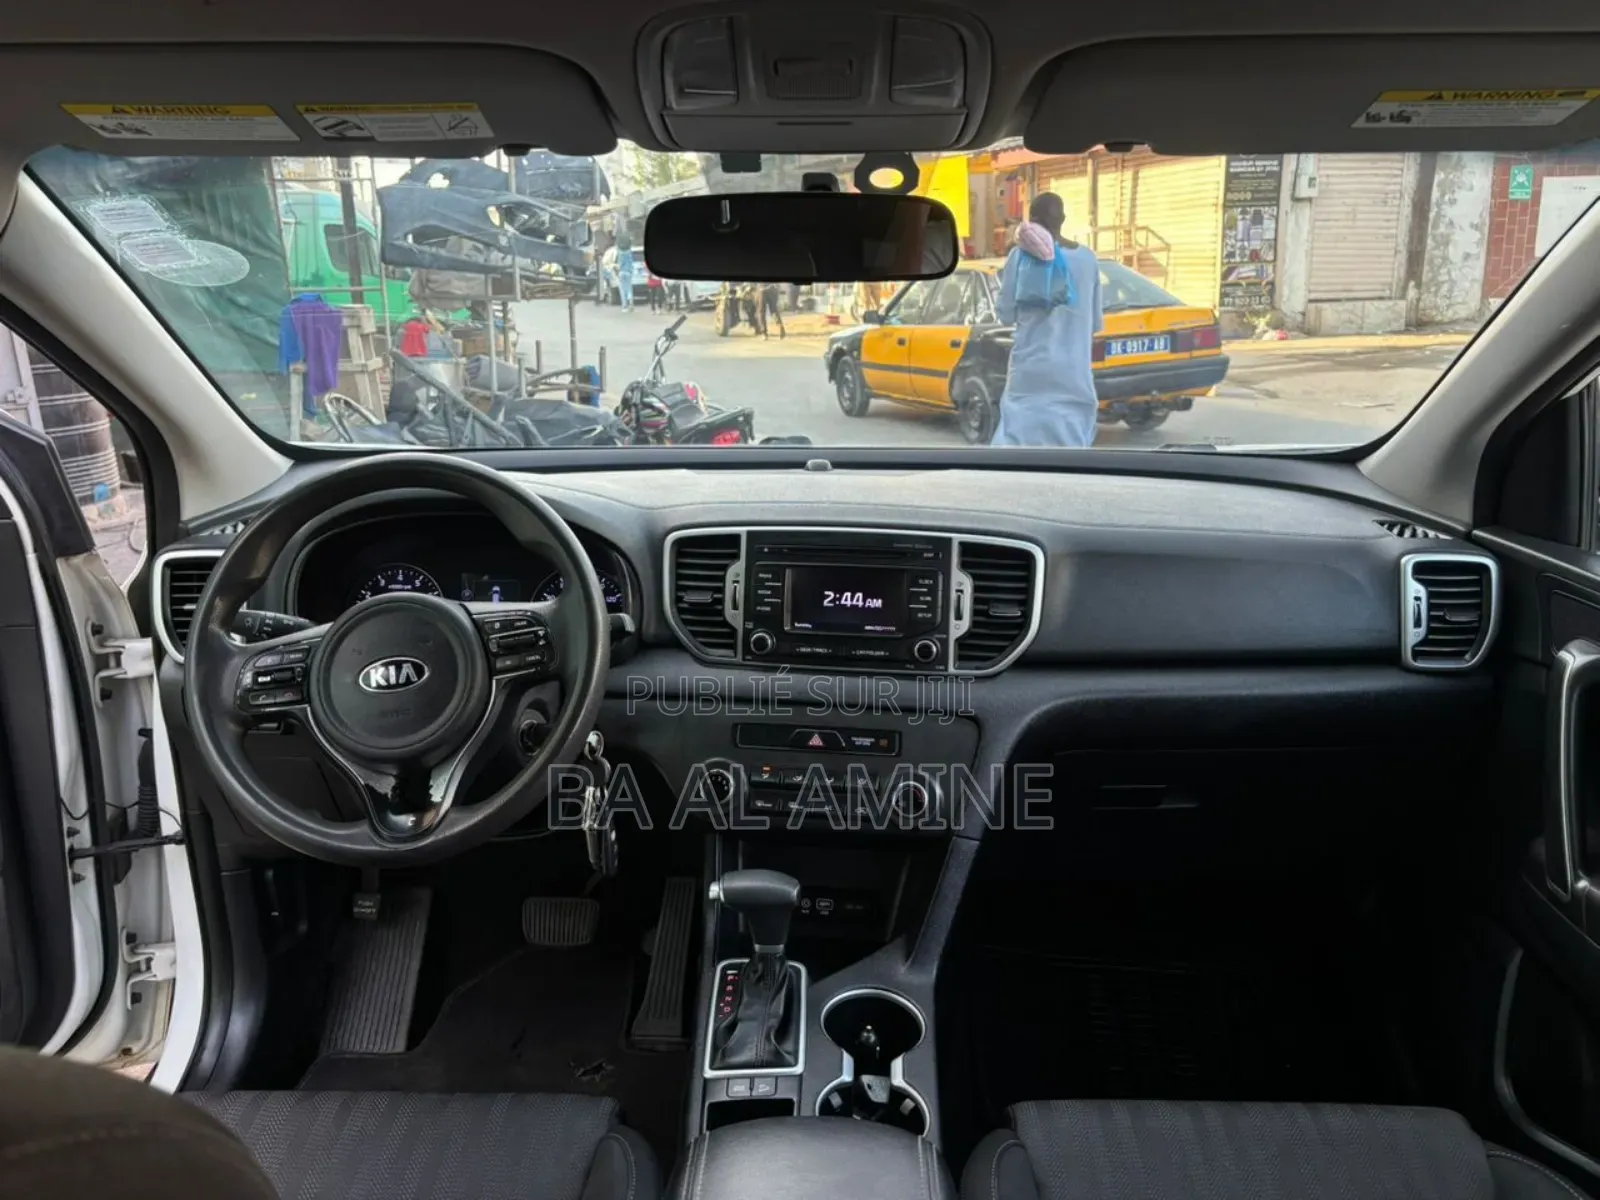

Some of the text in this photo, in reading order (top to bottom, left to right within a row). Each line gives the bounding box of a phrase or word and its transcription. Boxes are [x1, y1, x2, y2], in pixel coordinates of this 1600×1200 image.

[1452, 90, 1554, 100] WARNING
[131, 105, 231, 116] WARNING
[823, 590, 883, 609] 2:44 AM
[369, 663, 418, 688] KIA
